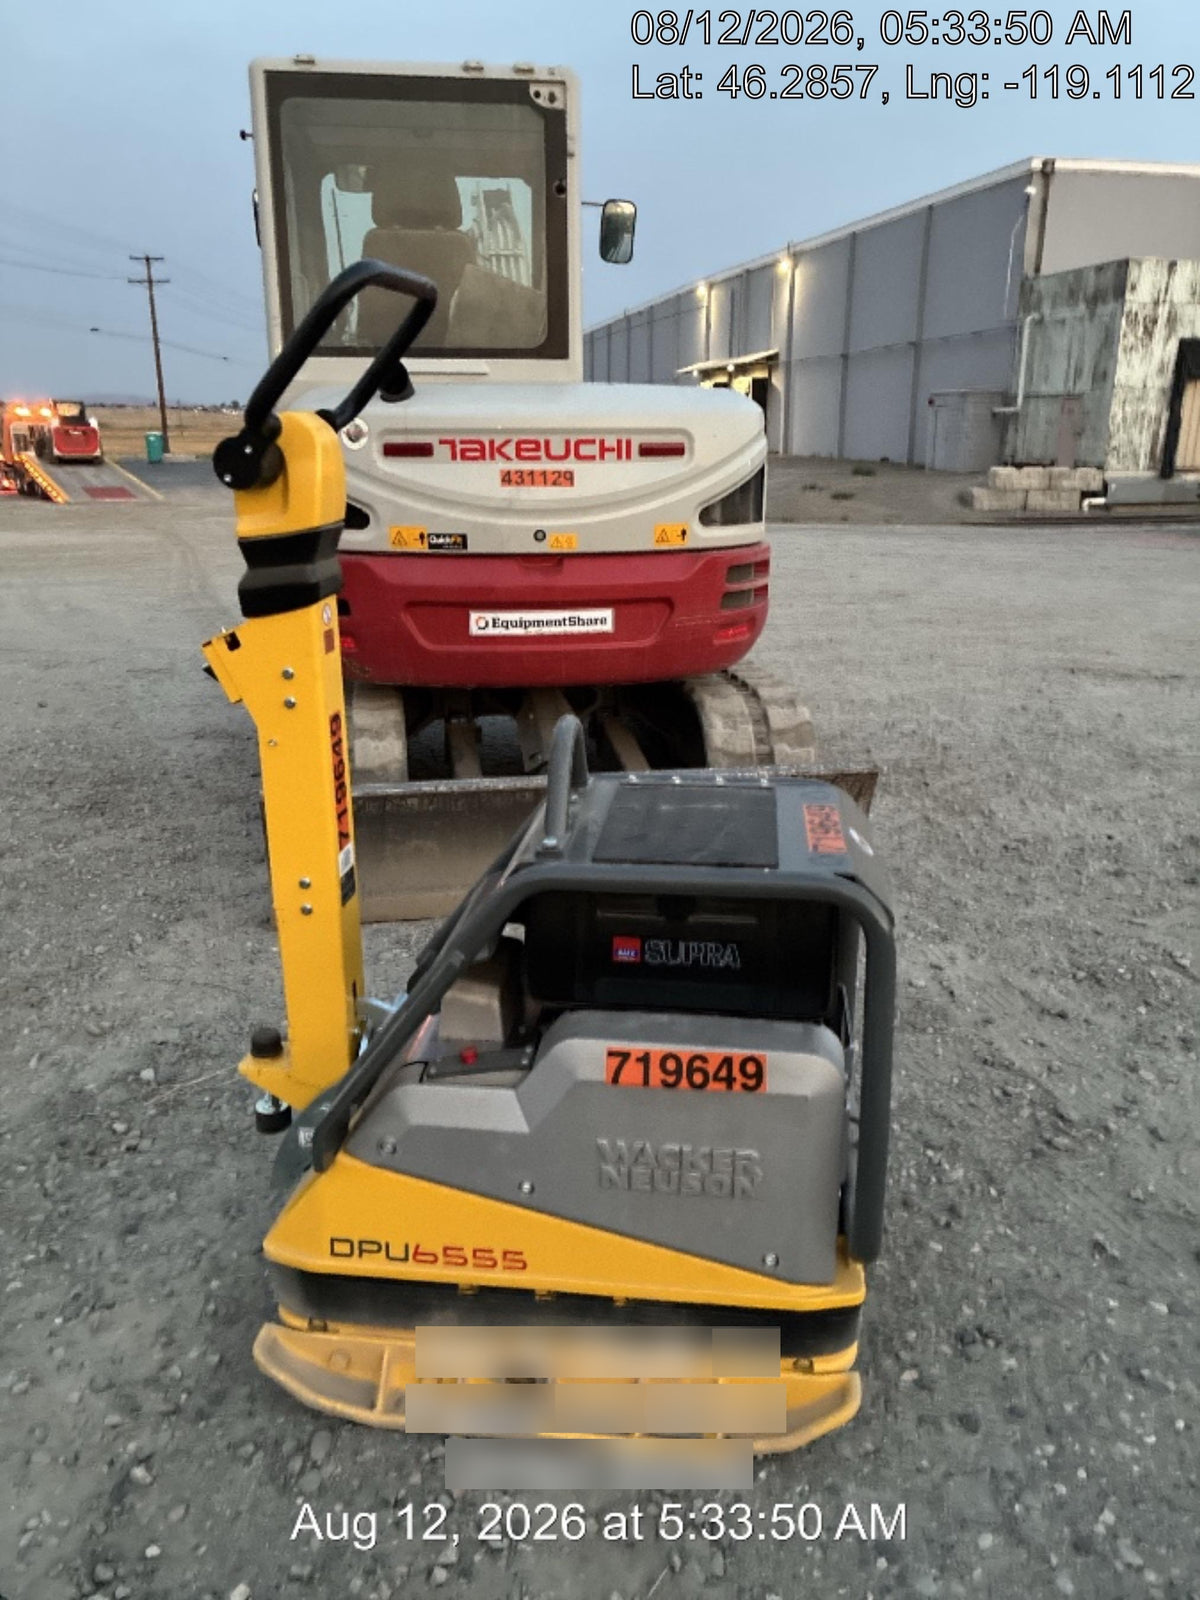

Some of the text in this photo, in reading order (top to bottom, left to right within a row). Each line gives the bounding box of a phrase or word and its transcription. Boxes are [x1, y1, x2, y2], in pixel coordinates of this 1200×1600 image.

[501, 469, 574, 486] 431129
[491, 615, 608, 630] EquipmentShare
[644, 939, 740, 968] SUPRA
[606, 1050, 764, 1092] 719649
[597, 1138, 763, 1179] WACKER
[329, 1236, 528, 1270] DPU6555
